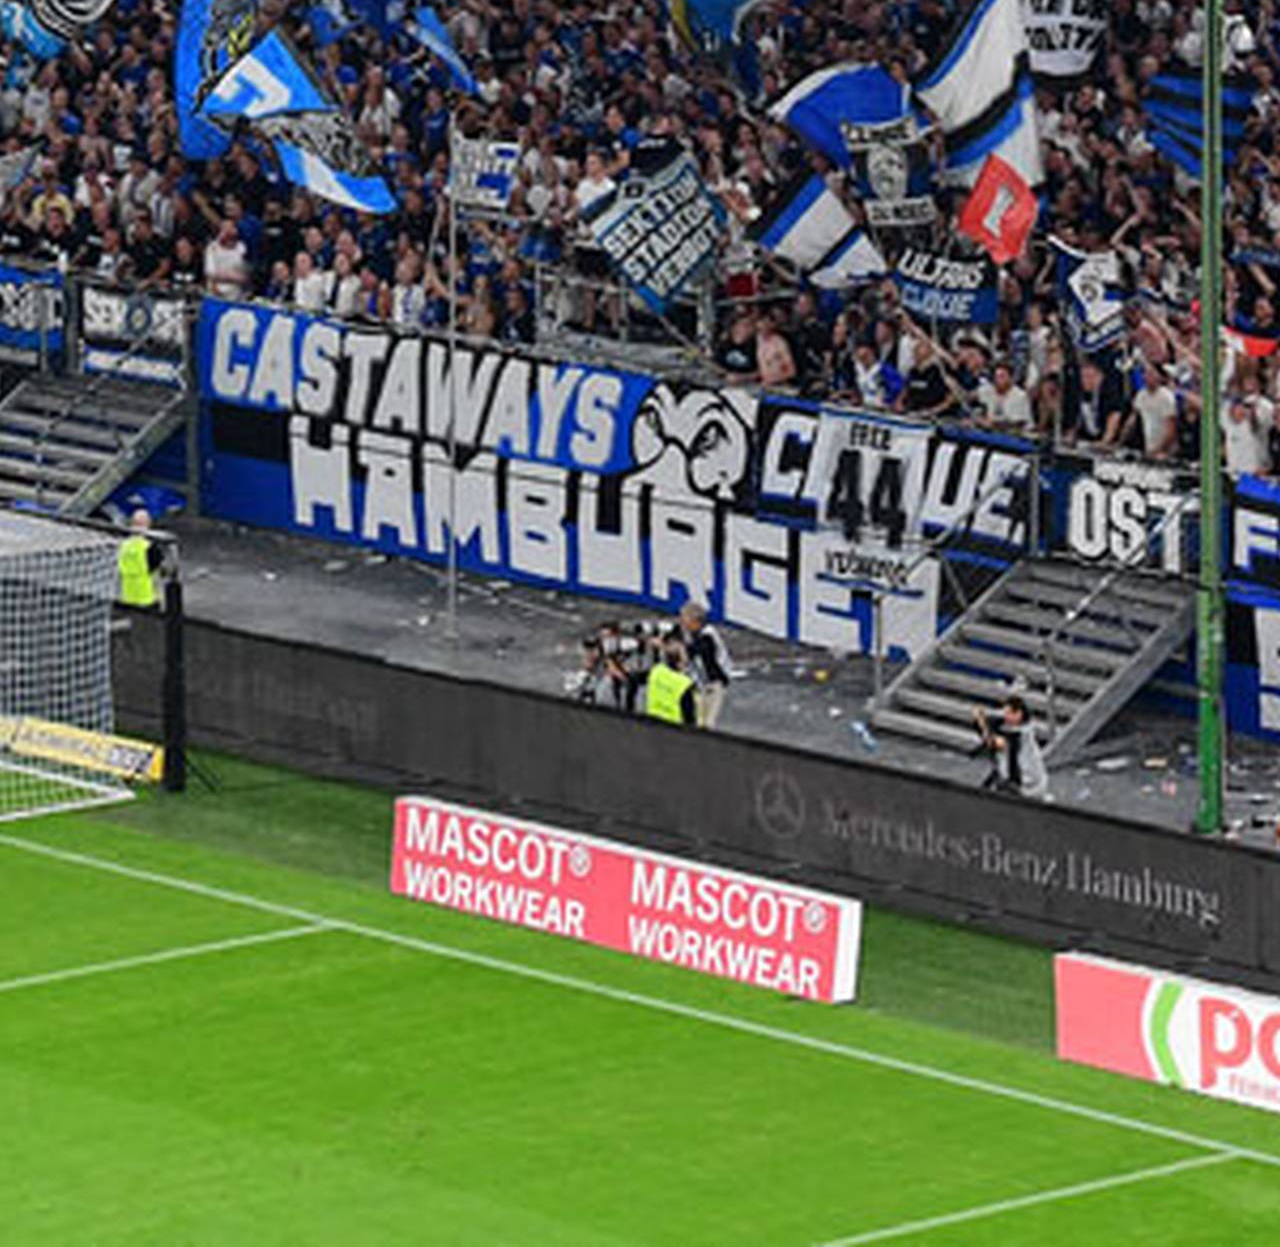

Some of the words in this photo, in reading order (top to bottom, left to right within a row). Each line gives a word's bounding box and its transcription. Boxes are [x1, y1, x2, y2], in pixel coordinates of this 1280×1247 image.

[211, 308, 623, 470] CASTAWAYS
[825, 448, 908, 551] 44
[1067, 476, 1202, 574] OST
[819, 798, 1059, 891] Mercedes-Benz
[1065, 848, 1223, 928] Hamburg
[401, 859, 586, 940] WORKWEAR
[628, 915, 821, 999] WORKWEAR
